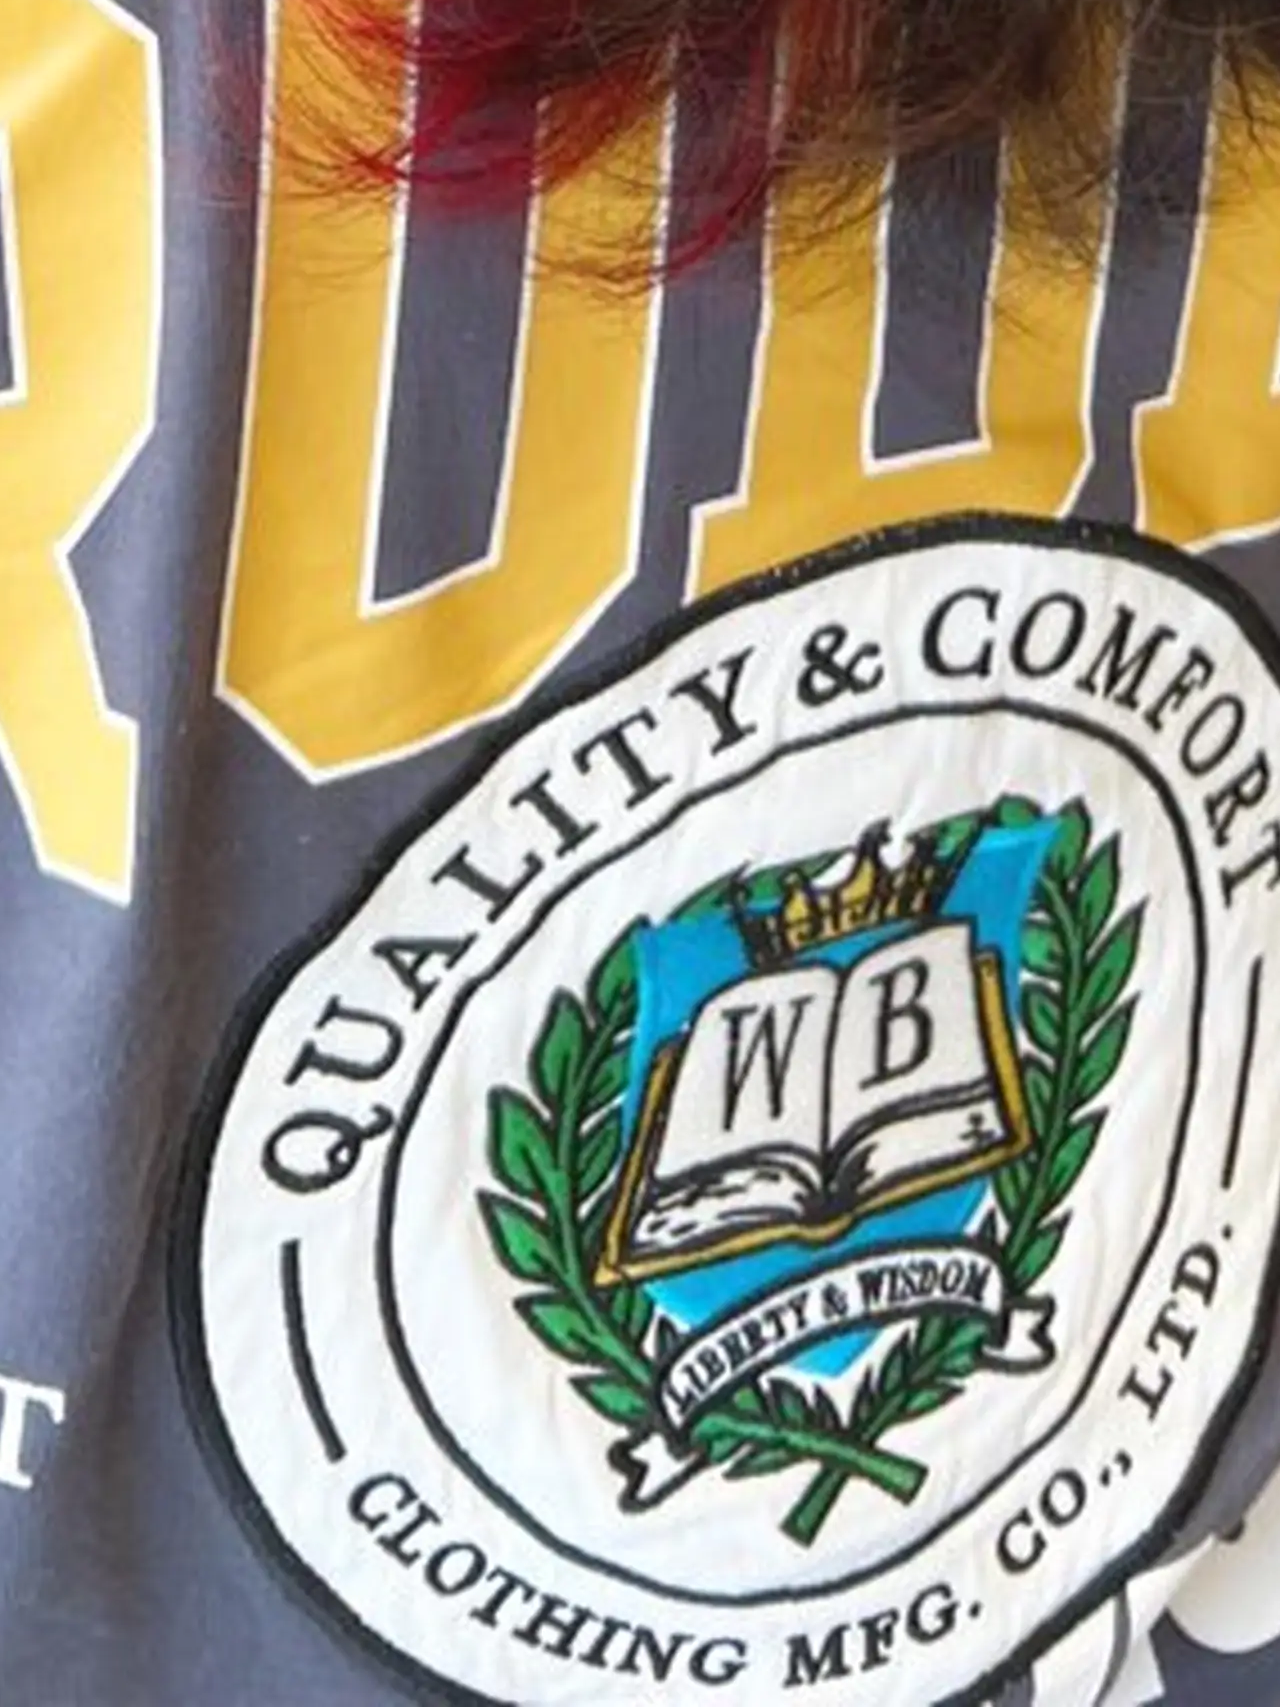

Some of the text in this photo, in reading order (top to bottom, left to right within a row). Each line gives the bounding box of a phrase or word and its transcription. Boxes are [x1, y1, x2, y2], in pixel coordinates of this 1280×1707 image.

[261, 643, 758, 1195] QUALITY
[797, 622, 884, 708] &
[348, 1223, 1234, 1690] CLOTHING MFG. CO., LTD.
[663, 1258, 992, 1413] LIBERTY & WISDOM
